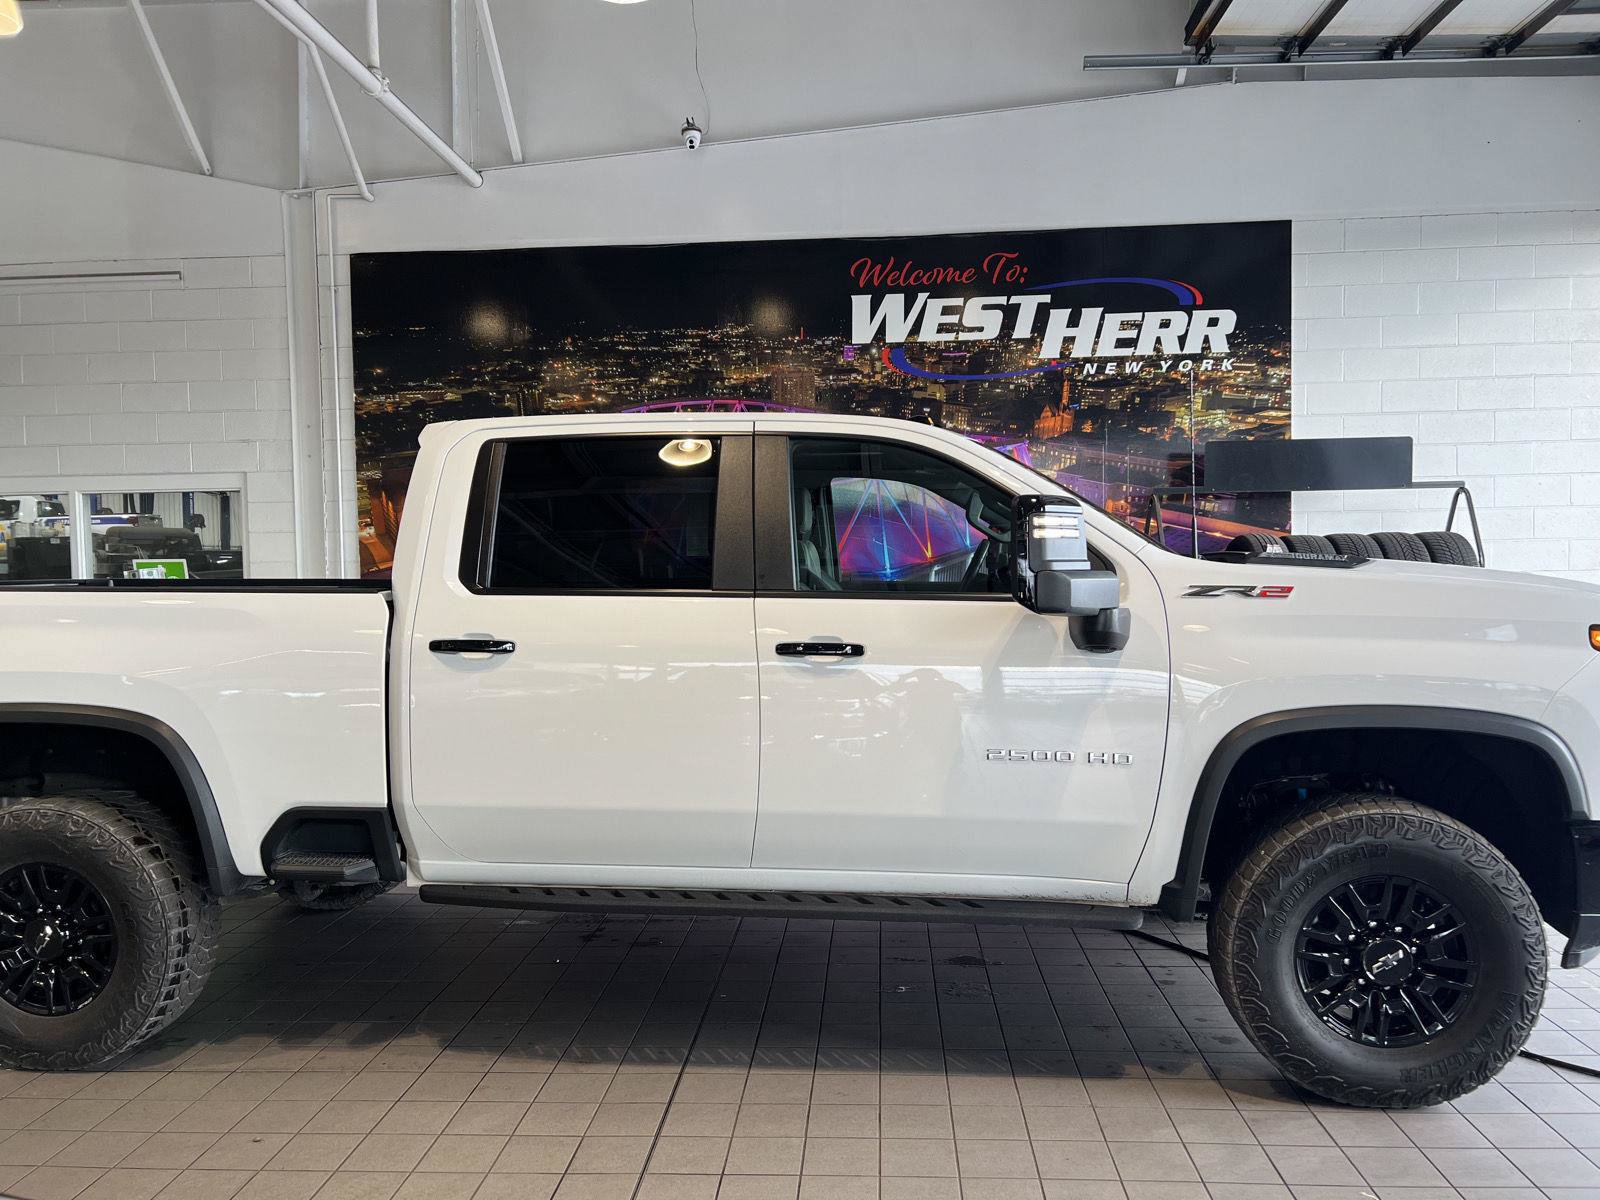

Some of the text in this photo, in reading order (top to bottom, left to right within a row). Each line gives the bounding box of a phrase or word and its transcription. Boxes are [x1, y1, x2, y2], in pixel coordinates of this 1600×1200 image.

[850, 251, 1029, 288] Welcome To:
[850, 292, 1238, 359] WEST HERR
[1082, 357, 1237, 376] NEW YORK
[1294, 552, 1348, 562] DURAMAX
[1181, 584, 1295, 599] ZR2
[986, 748, 1134, 765] 2500 HD
